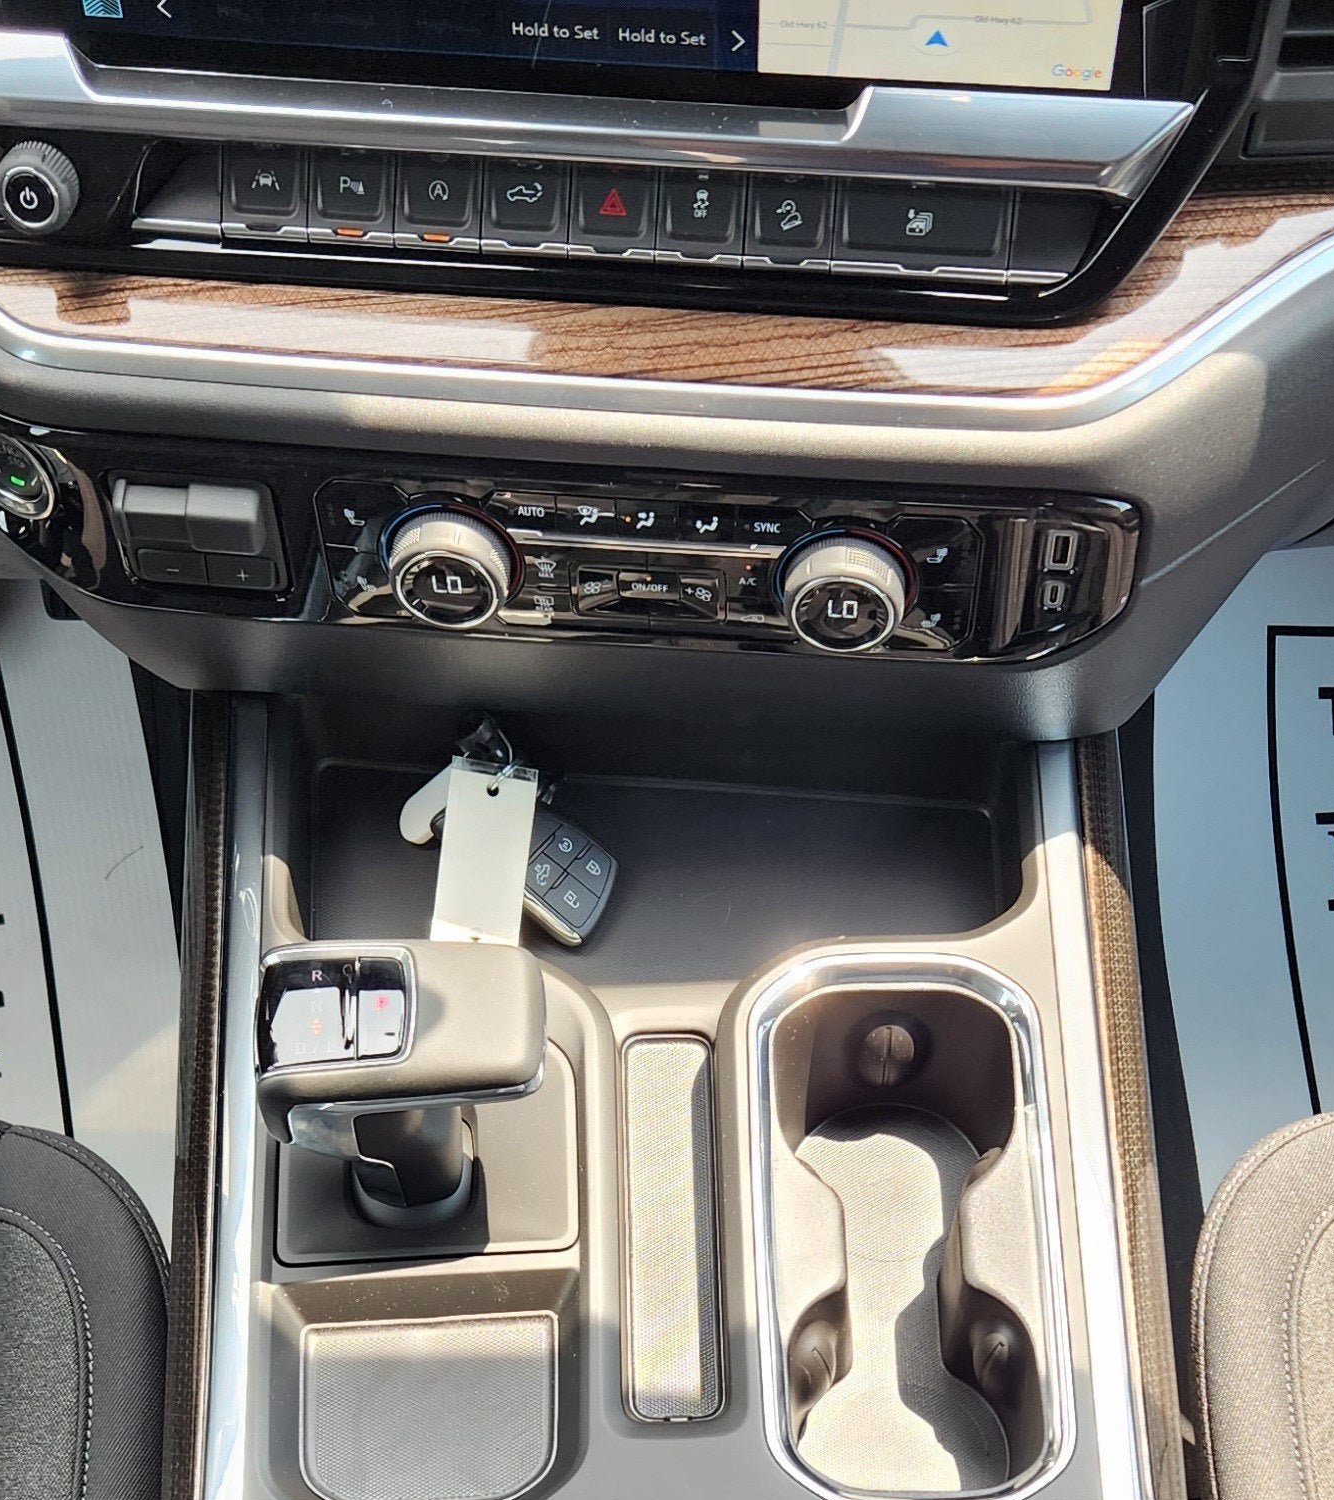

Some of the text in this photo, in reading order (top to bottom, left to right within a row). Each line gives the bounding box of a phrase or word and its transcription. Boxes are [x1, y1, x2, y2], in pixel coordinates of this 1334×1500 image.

[511, 21, 600, 40] Hold to Set
[618, 28, 707, 46] Hold to Set
[1052, 64, 1102, 81] Google
[693, 209, 708, 218] OFF
[517, 505, 545, 518] AUTO
[753, 522, 781, 534] SYNC
[431, 574, 463, 595] LO
[631, 582, 669, 593] ON/OFF
[738, 576, 757, 587] A/C
[827, 599, 858, 619] LO
[311, 969, 323, 982] R
